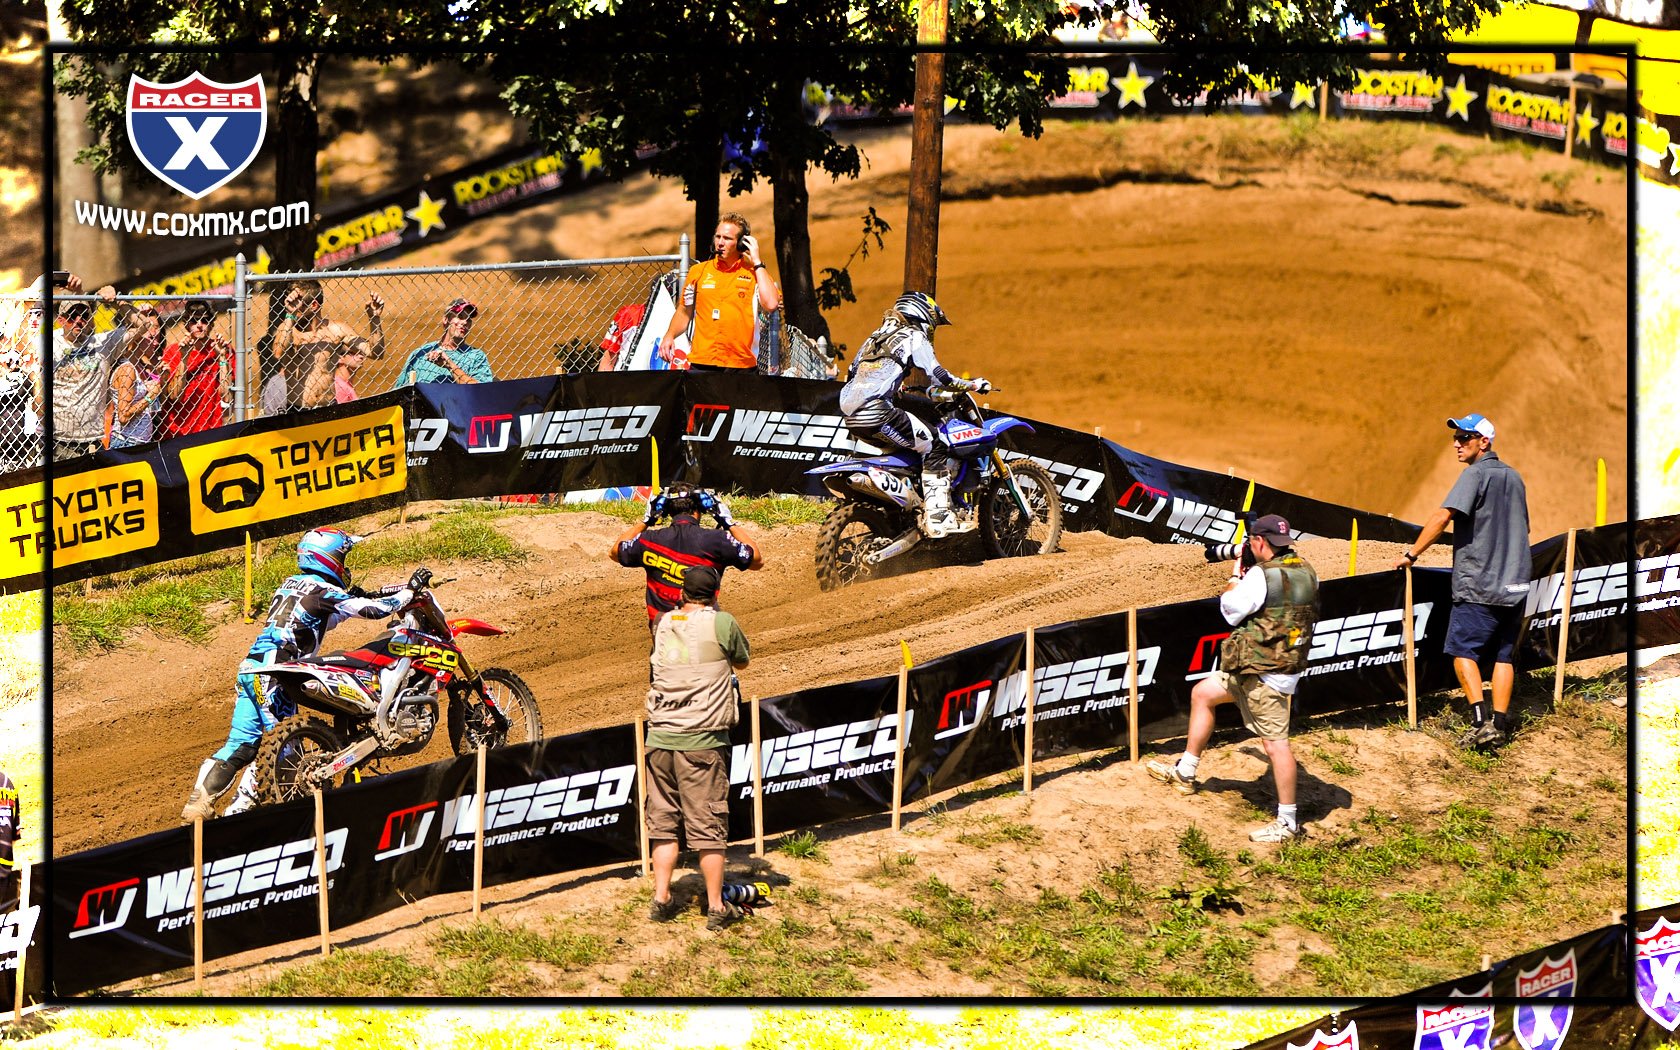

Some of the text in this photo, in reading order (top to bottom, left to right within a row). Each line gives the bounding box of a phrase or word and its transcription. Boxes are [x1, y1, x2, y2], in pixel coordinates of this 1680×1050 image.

[271, 423, 394, 471] TOYOTA
[952, 428, 982, 440] VMS
[522, 443, 639, 461] Performance Products
[732, 445, 814, 462] Performance
[275, 453, 395, 500] TRUCKS
[7, 478, 143, 526] TOYOTA
[9, 509, 145, 558] TRUCKS
[643, 551, 688, 579] GEIC
[1529, 606, 1617, 631] Perfrmance
[388, 642, 459, 667] GEICO
[1358, 648, 1419, 668] Producs
[1001, 692, 1145, 732] Perfrmance Producs
[740, 773, 831, 799] Prformance
[445, 813, 619, 853] Perormance Products
[157, 878, 334, 932] Perfrmance Producs
[1520, 967, 1571, 994] RACER
